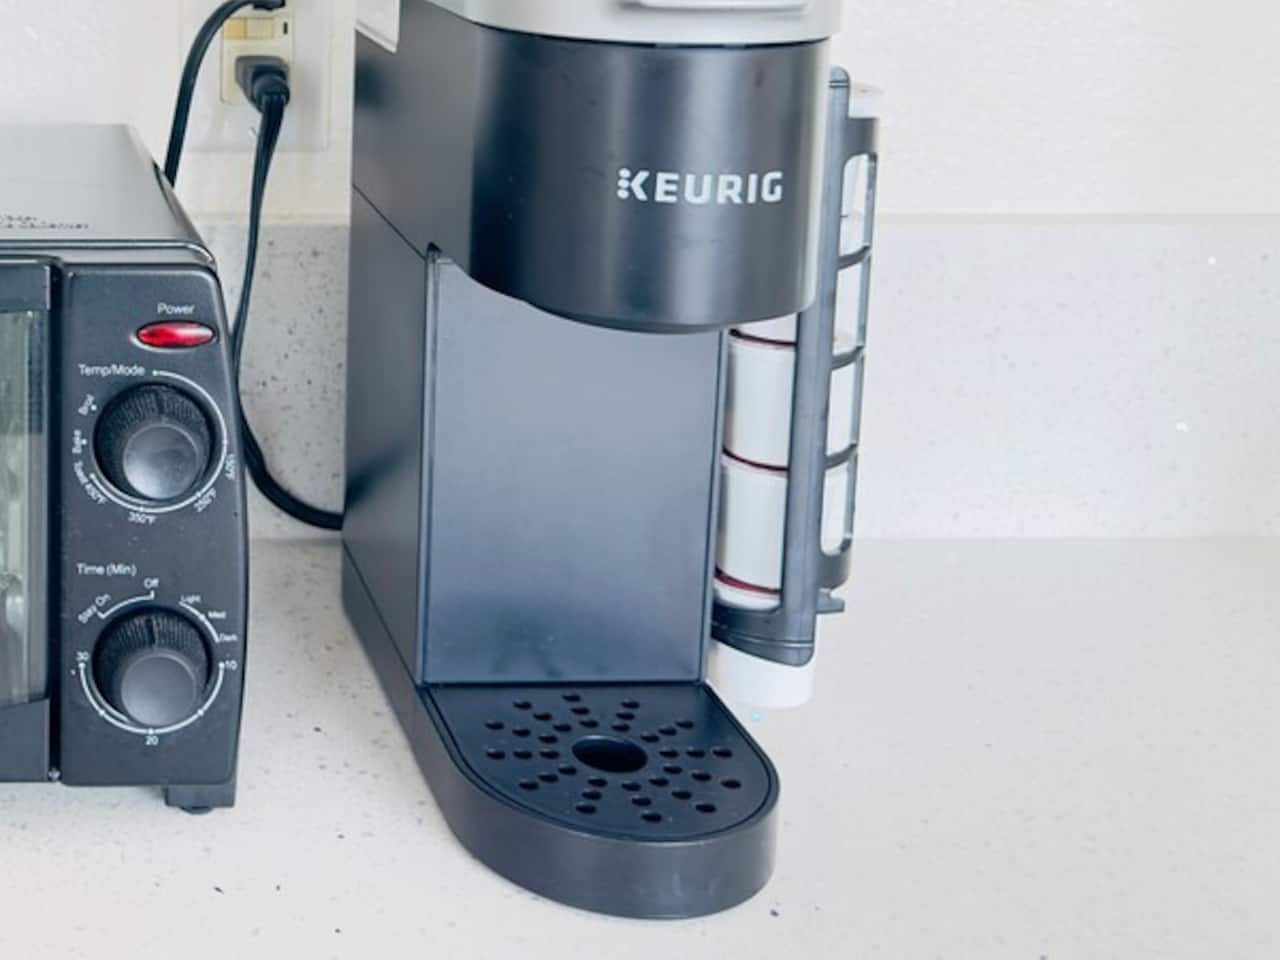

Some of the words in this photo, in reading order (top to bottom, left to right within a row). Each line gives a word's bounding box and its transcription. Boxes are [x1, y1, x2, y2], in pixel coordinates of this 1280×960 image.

[616, 167, 784, 205] KEURIG
[156, 302, 195, 315] Power
[77, 363, 146, 378] Temp/Mode
[76, 563, 105, 575] Time
[106, 562, 137, 577] (Min)
[143, 577, 160, 589] Off
[145, 736, 160, 747] 20
